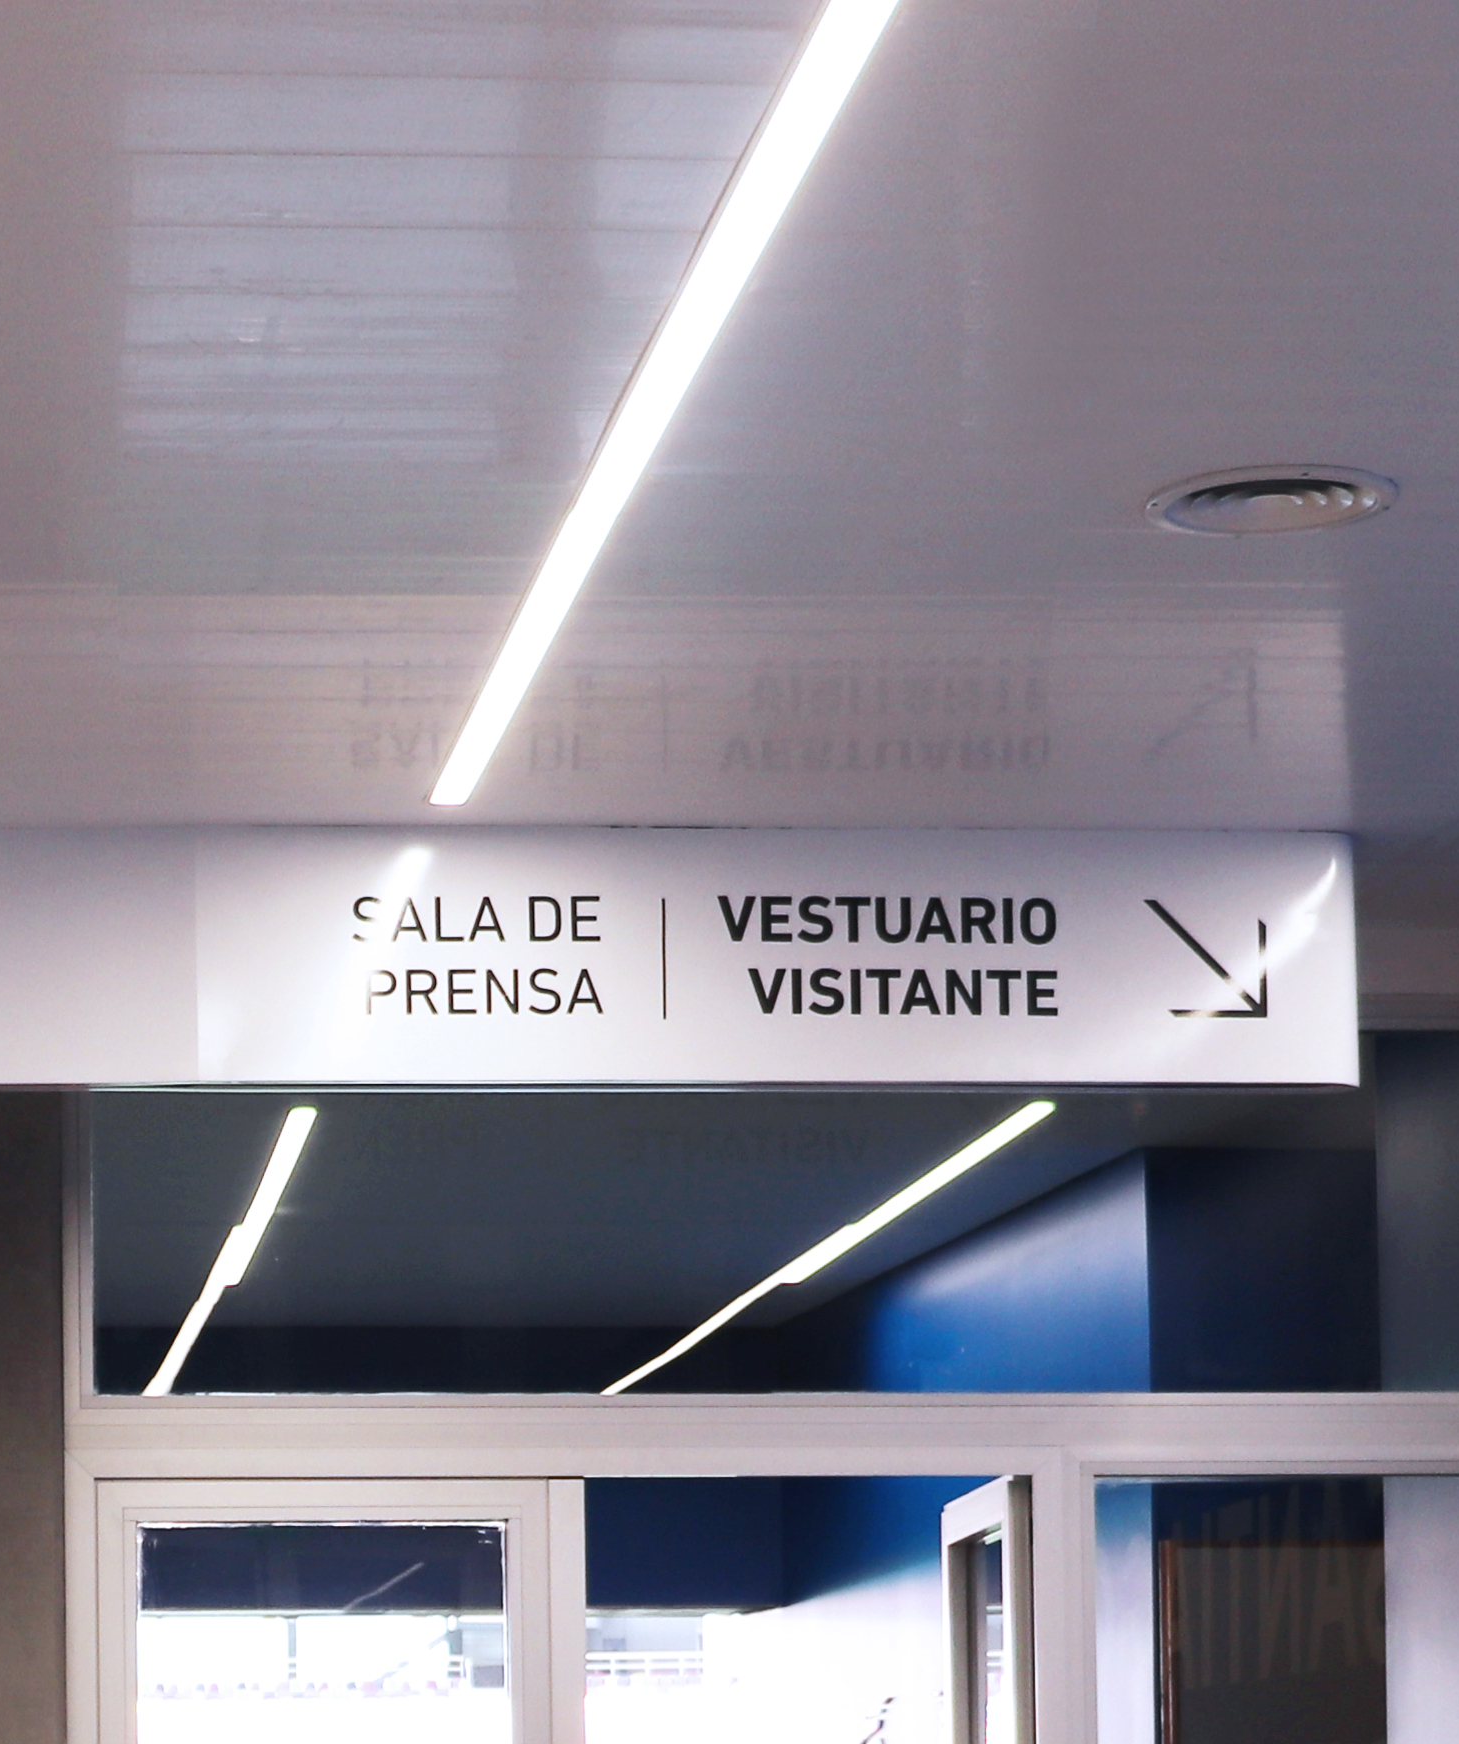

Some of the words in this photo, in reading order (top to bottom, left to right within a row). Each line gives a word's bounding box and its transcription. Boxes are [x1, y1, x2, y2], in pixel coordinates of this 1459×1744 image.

[352, 895, 506, 943] SALA
[527, 895, 602, 943] DE
[716, 896, 1058, 945] VESTUARIO
[366, 967, 604, 1016] PRENSA
[747, 967, 1059, 1017] VISITANTE
